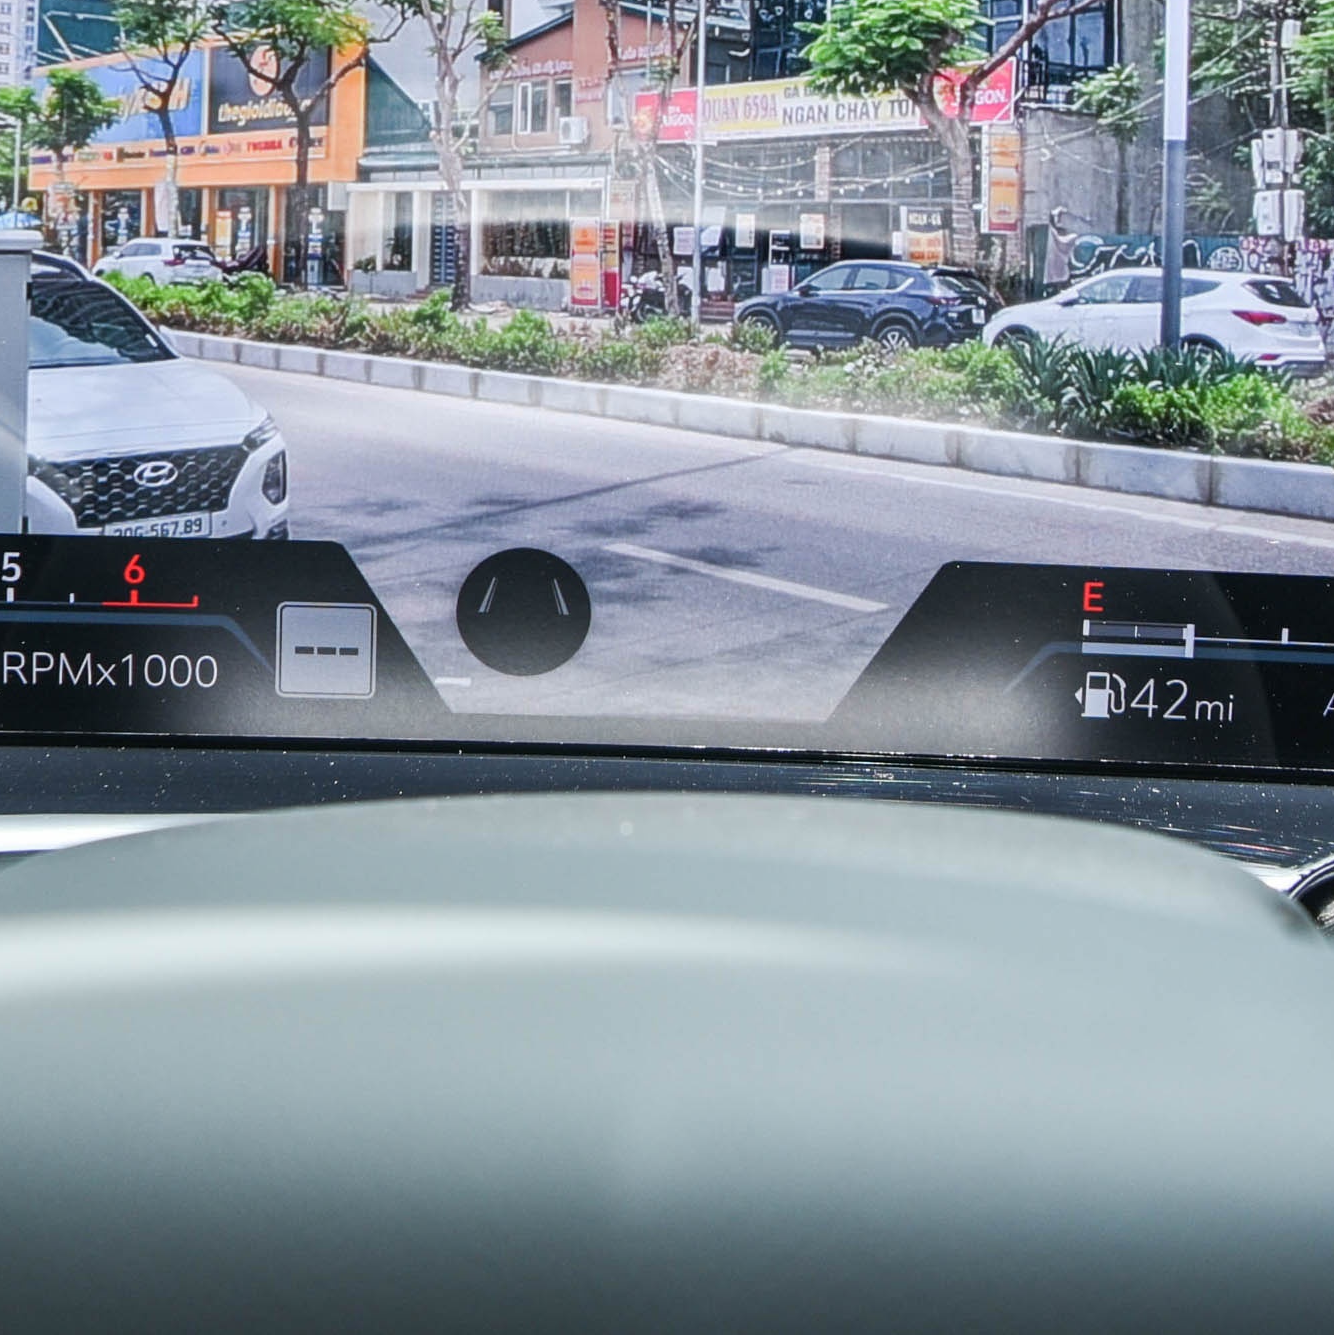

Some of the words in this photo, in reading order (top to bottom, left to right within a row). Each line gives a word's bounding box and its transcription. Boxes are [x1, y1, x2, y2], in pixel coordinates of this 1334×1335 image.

[1, 552, 22, 582] 5
[124, 554, 145, 584] 6
[1082, 582, 1105, 613] E
[3, 651, 218, 688] RPMx1000
